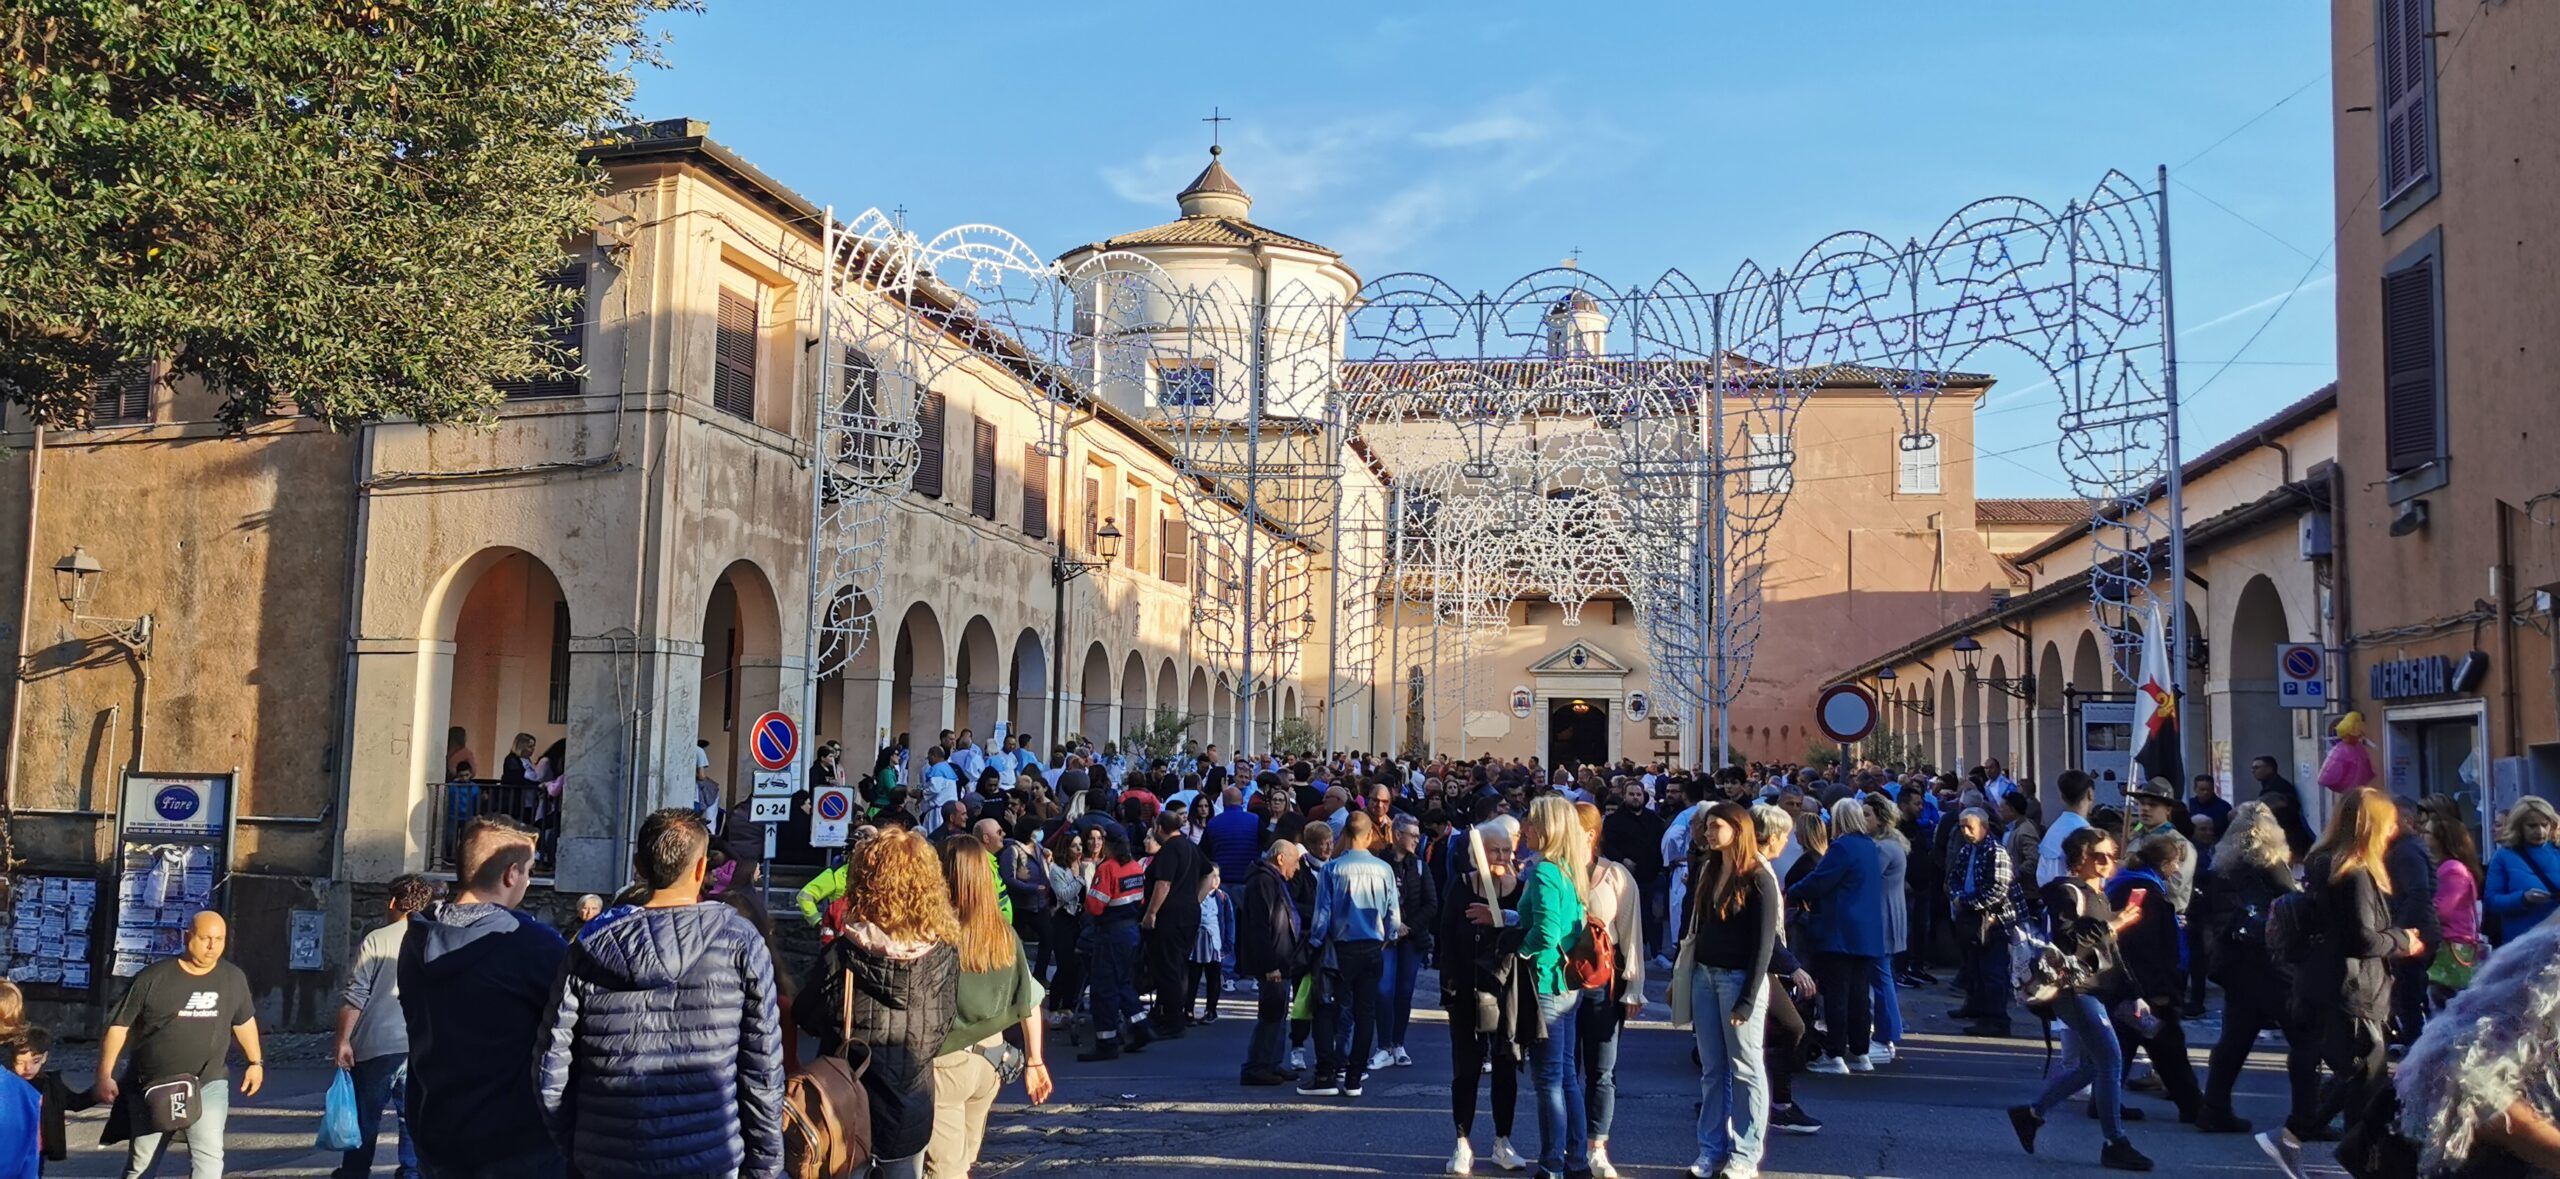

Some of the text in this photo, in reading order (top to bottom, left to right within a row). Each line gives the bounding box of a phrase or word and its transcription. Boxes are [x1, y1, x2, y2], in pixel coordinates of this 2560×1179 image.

[2369, 656, 2446, 699] MERCERIA
[162, 796, 192, 810] Fiore
[771, 804, 786, 815] 24
[174, 1092, 187, 1119] EA7
